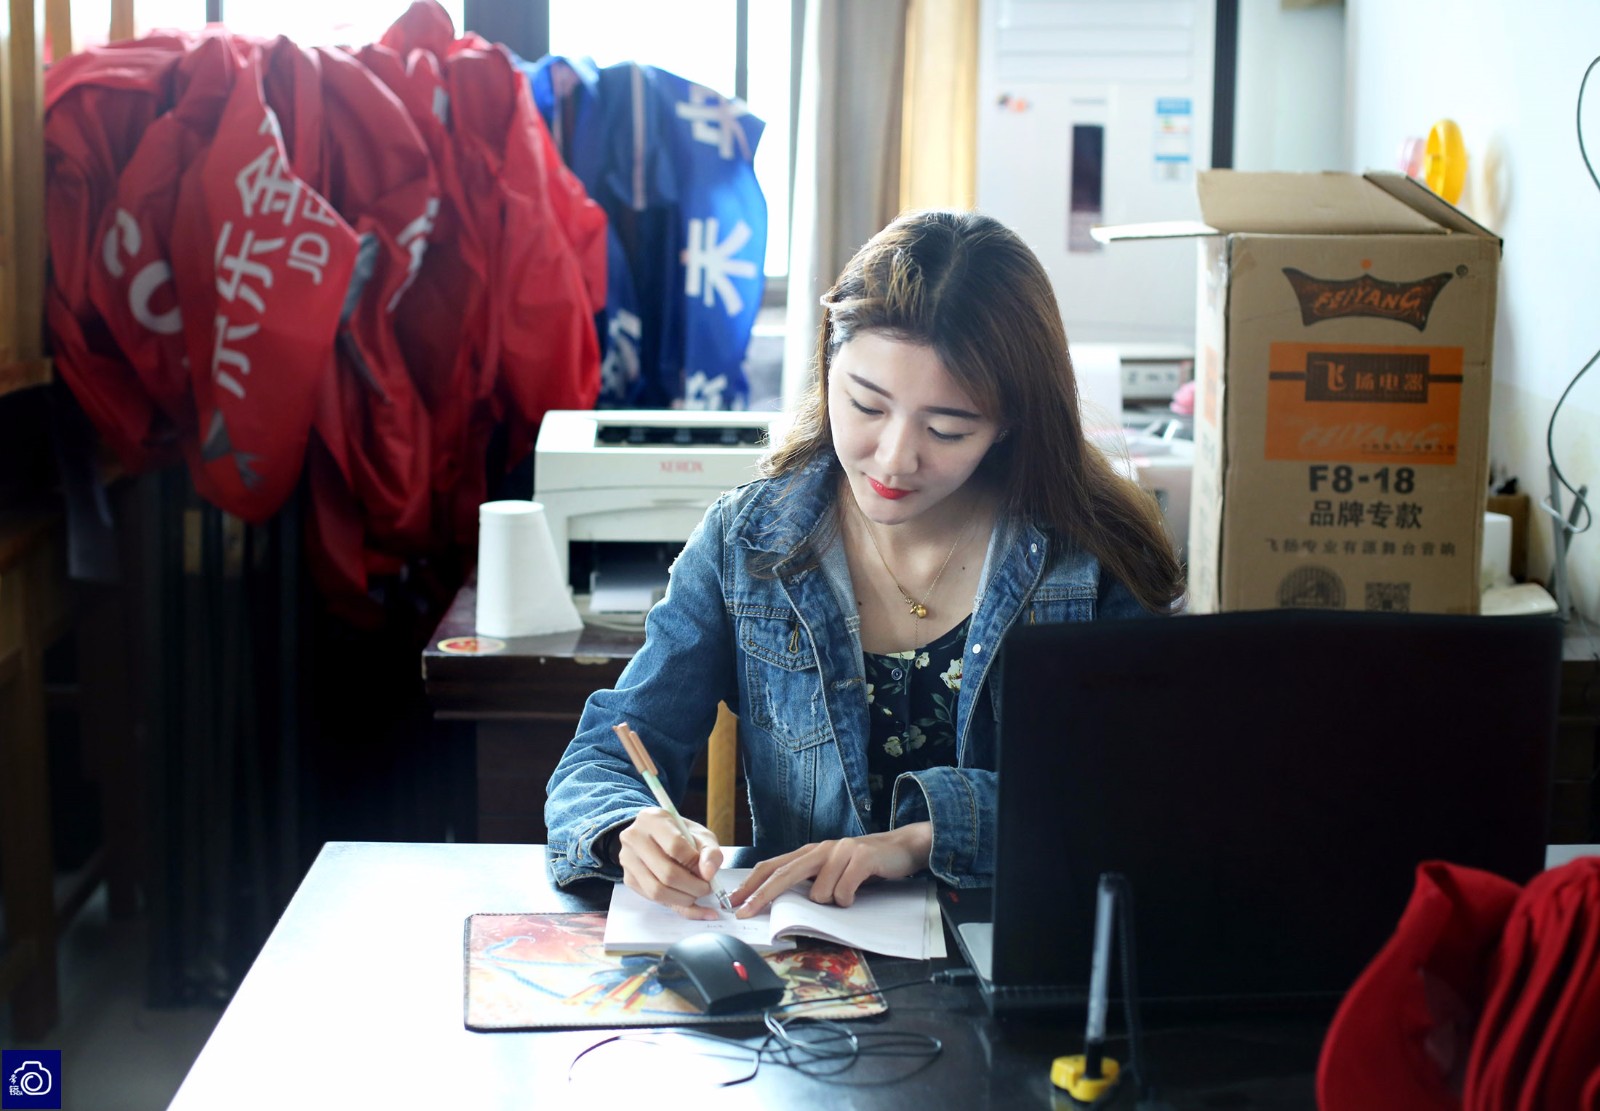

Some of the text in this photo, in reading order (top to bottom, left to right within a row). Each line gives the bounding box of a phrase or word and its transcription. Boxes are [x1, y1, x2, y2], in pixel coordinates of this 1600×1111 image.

[1308, 465, 1415, 494] F8-18
[1309, 499, 1422, 529] 品牌专款
